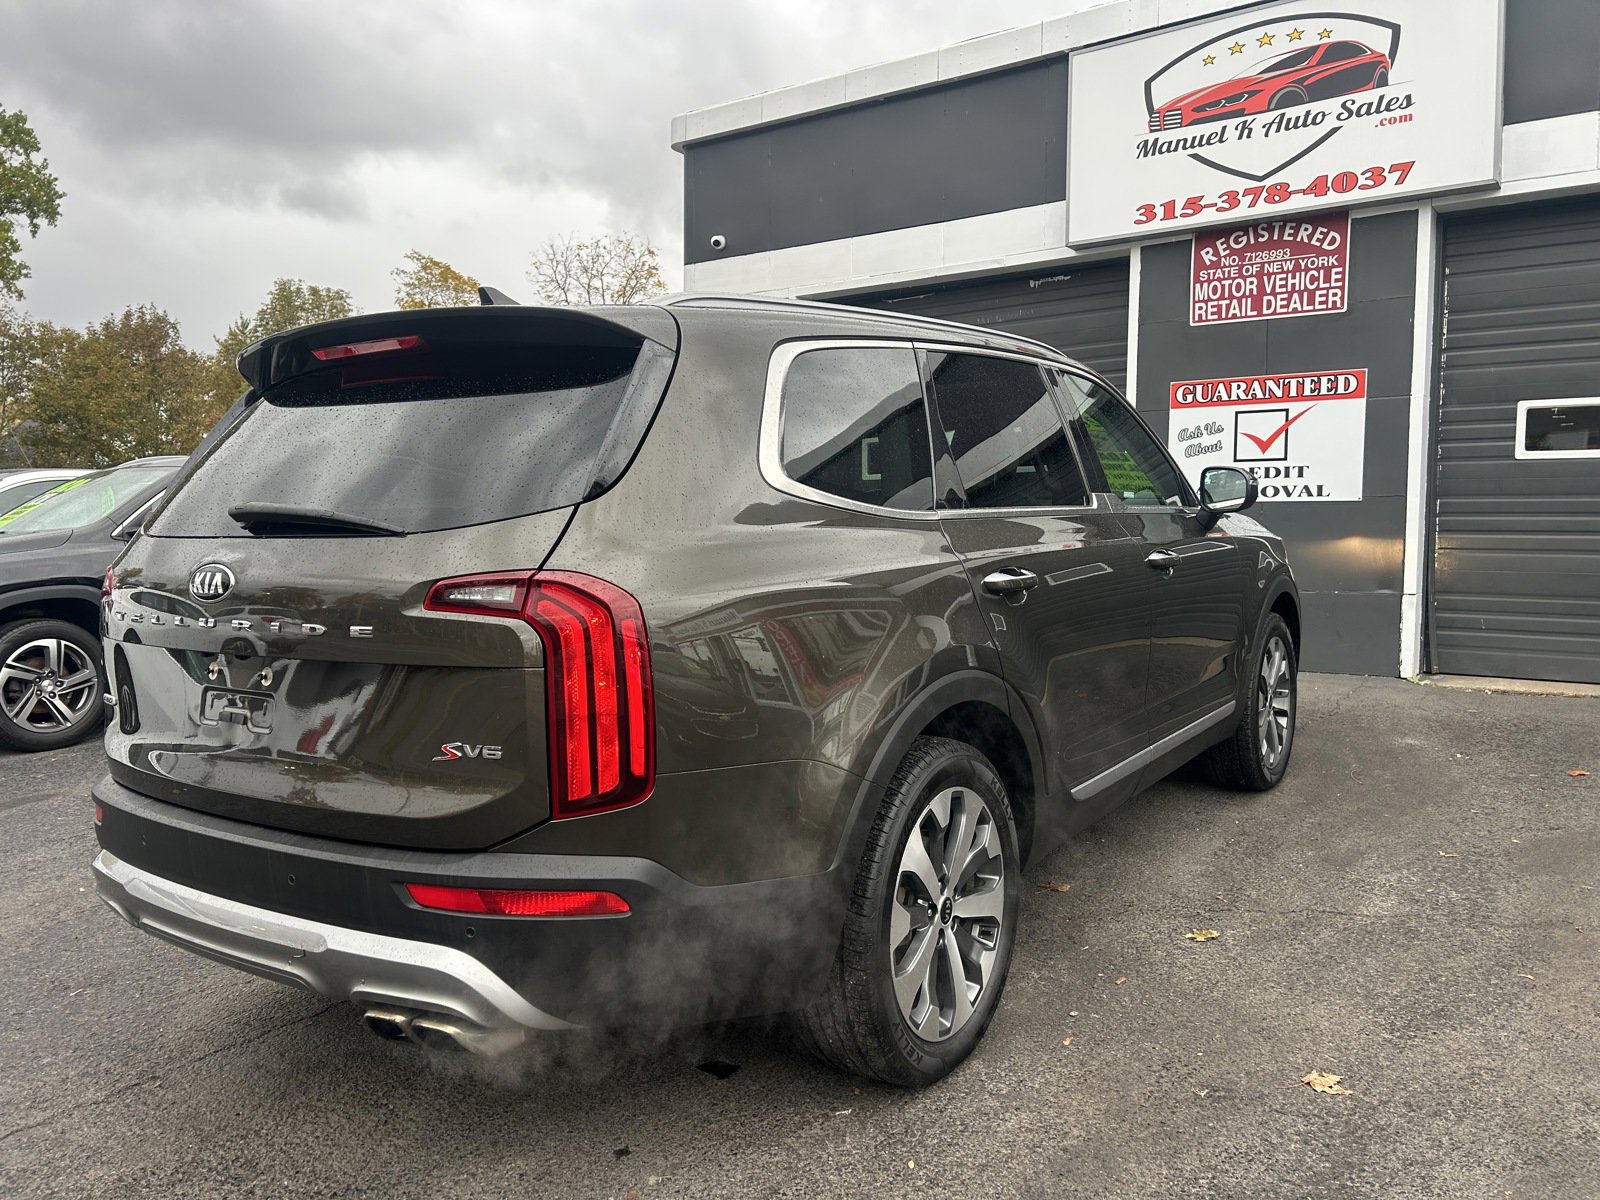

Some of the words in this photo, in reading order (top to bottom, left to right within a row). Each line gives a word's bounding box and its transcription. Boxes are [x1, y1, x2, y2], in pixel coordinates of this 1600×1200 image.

[1136, 124, 1229, 159] Manuel
[1235, 118, 1257, 141] K
[1262, 109, 1332, 138] Auto
[1336, 93, 1416, 122] Sales
[1374, 113, 1413, 128] .com
[1134, 160, 1416, 225] 315-378-4037
[1200, 222, 1341, 266] REGISTERED
[1200, 267, 1239, 281] STATE
[1242, 264, 1261, 276] OF
[1264, 260, 1295, 274] NEW
[1299, 254, 1339, 269] YORK
[1220, 255, 1242, 267] NO.
[1244, 248, 1291, 263] 7126993
[1195, 277, 1258, 302] MOTOR
[1263, 267, 1343, 294] VEHICLE
[1194, 298, 1258, 321] RETAIL
[1262, 288, 1342, 314] DEALER
[1175, 373, 1359, 405] GUARANTEED
[1178, 426, 1203, 442] Ask
[1204, 422, 1225, 436] Us
[1185, 440, 1223, 458] About
[1248, 465, 1310, 479] EDIT
[1257, 484, 1331, 498] OVAL
[193, 571, 224, 595] KIA
